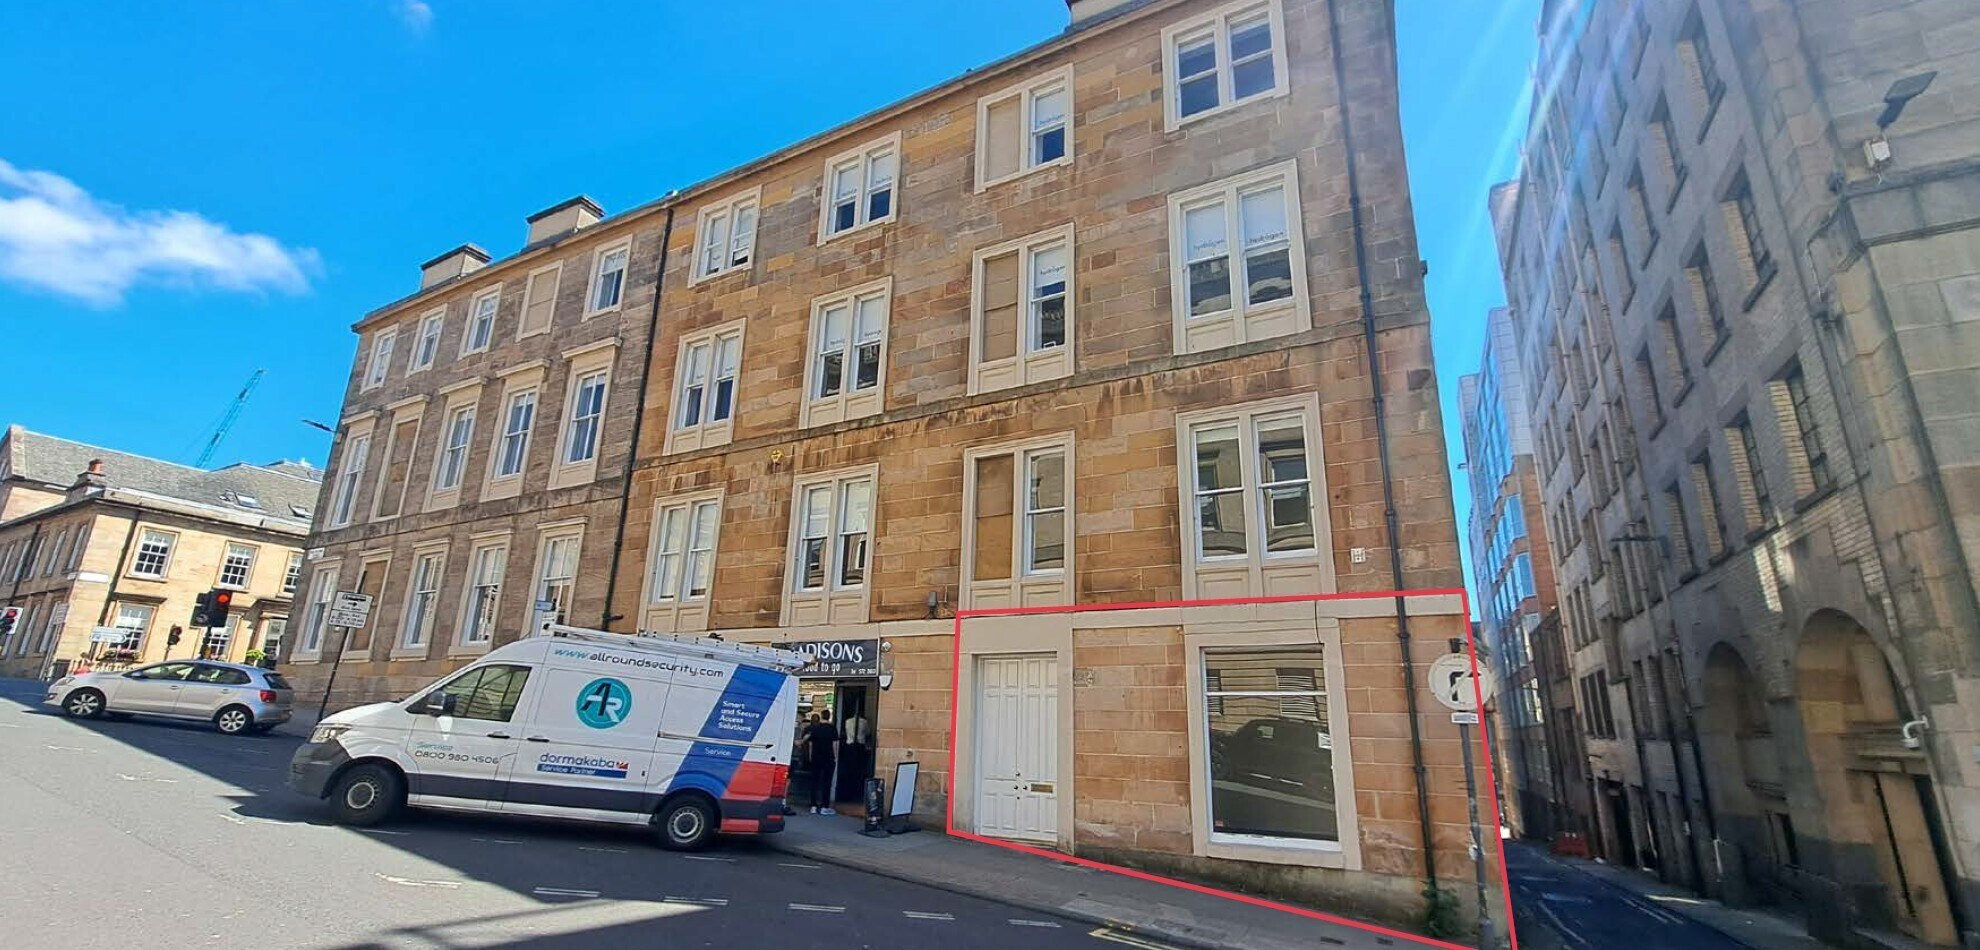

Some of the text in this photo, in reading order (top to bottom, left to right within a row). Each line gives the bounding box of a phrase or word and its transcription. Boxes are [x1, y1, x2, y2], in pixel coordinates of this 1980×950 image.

[797, 642, 864, 663] ADISONS
[554, 648, 724, 678] www.allroundsecurity.com
[831, 663, 841, 675] go
[722, 701, 745, 709] Smart
[719, 715, 744, 723] Access
[736, 709, 760, 719] Secure
[718, 722, 752, 731] Solutions
[415, 750, 446, 760] 0800
[705, 746, 731, 756] Service
[540, 752, 615, 768] dormakaba
[541, 764, 596, 775] Service Partner
